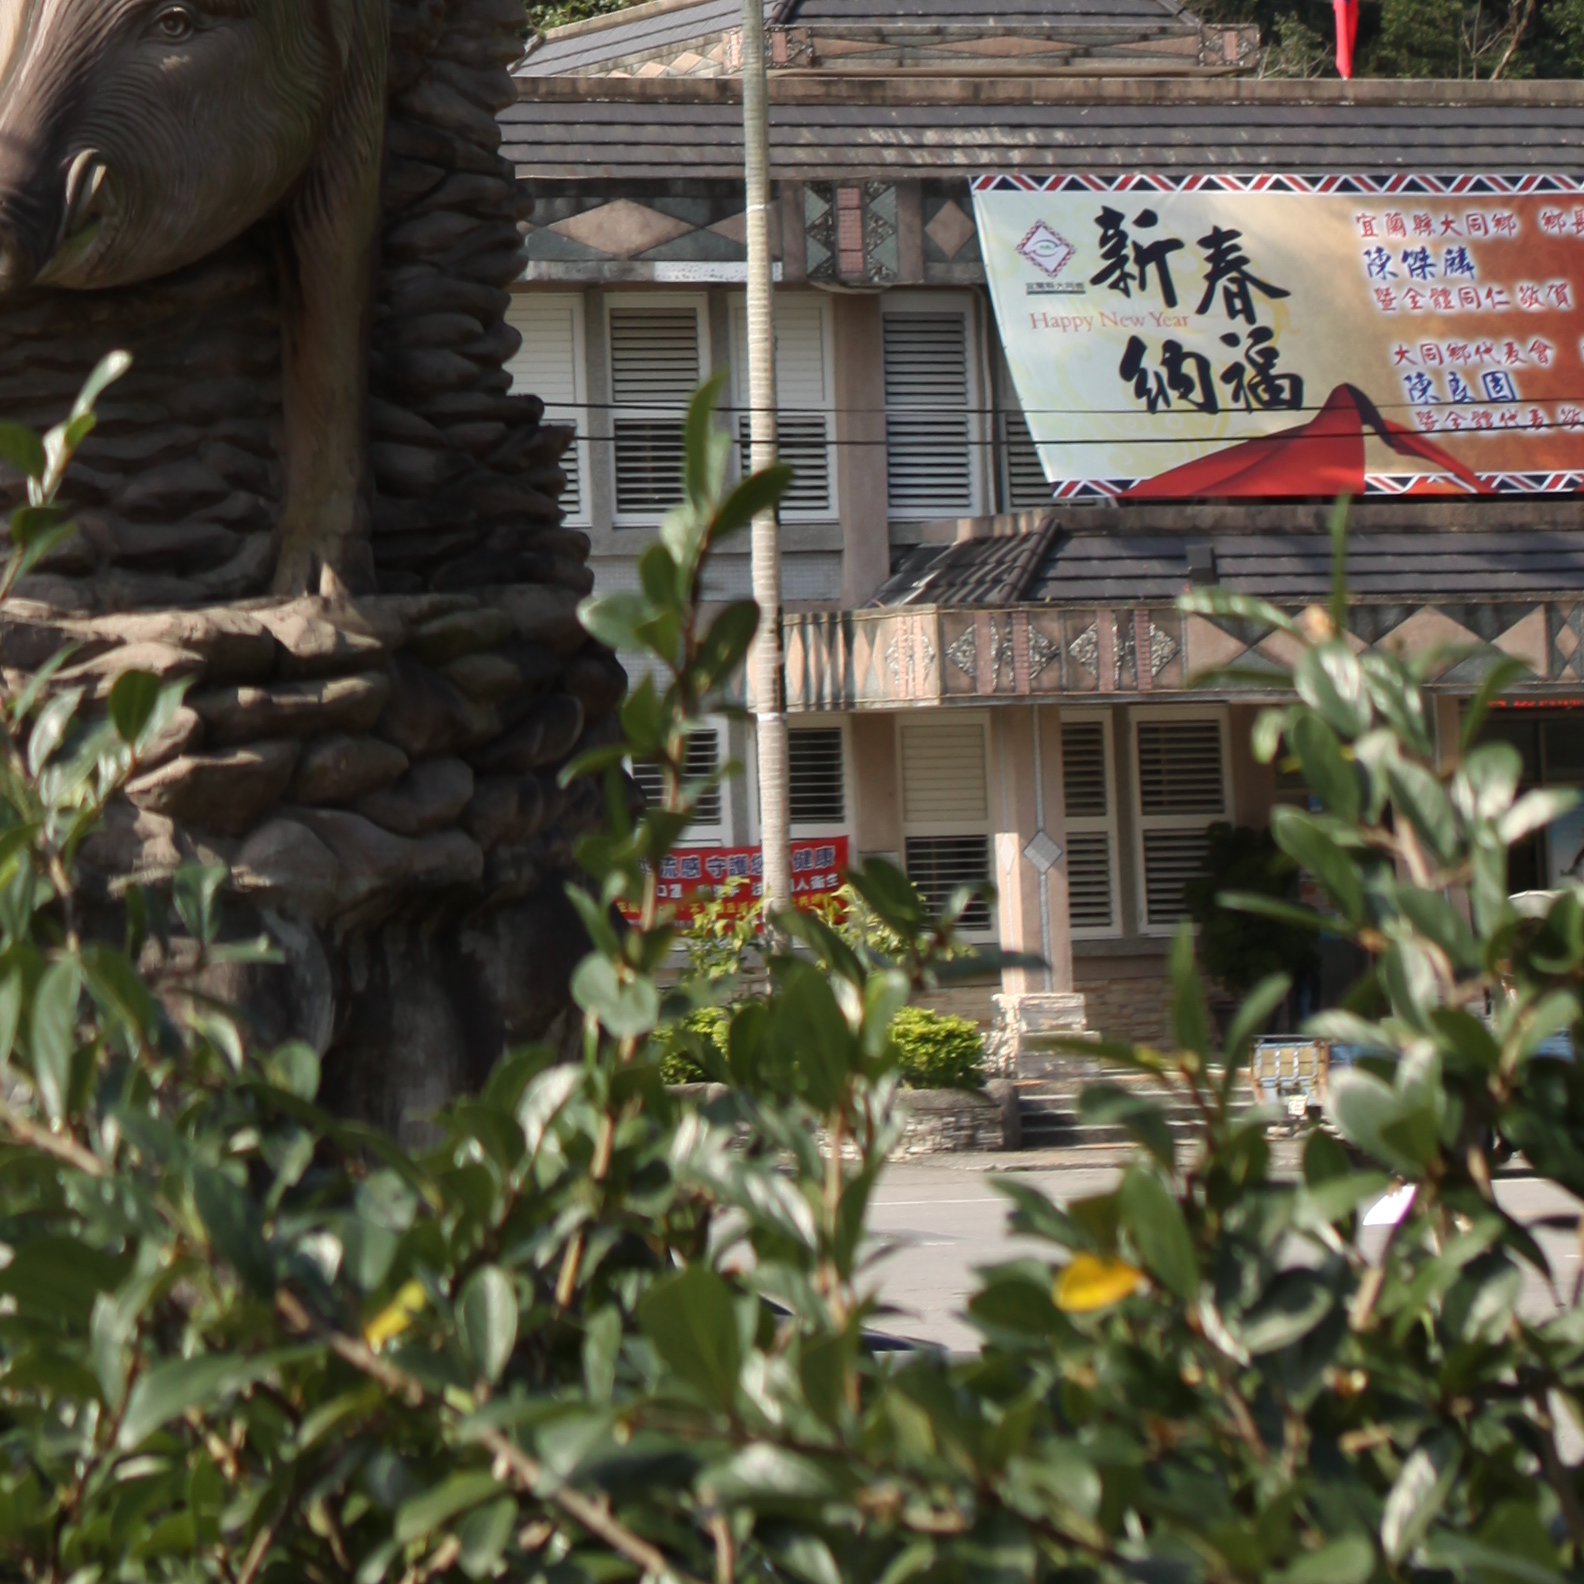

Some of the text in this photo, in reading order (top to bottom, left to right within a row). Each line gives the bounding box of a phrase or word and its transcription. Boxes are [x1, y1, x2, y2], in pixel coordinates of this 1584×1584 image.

[1354, 211, 1518, 239] 宜蘭縣大同鄉
[1089, 205, 1292, 325] 新春
[1029, 312, 1191, 333] Happy New Year
[1119, 326, 1304, 414] 納福
